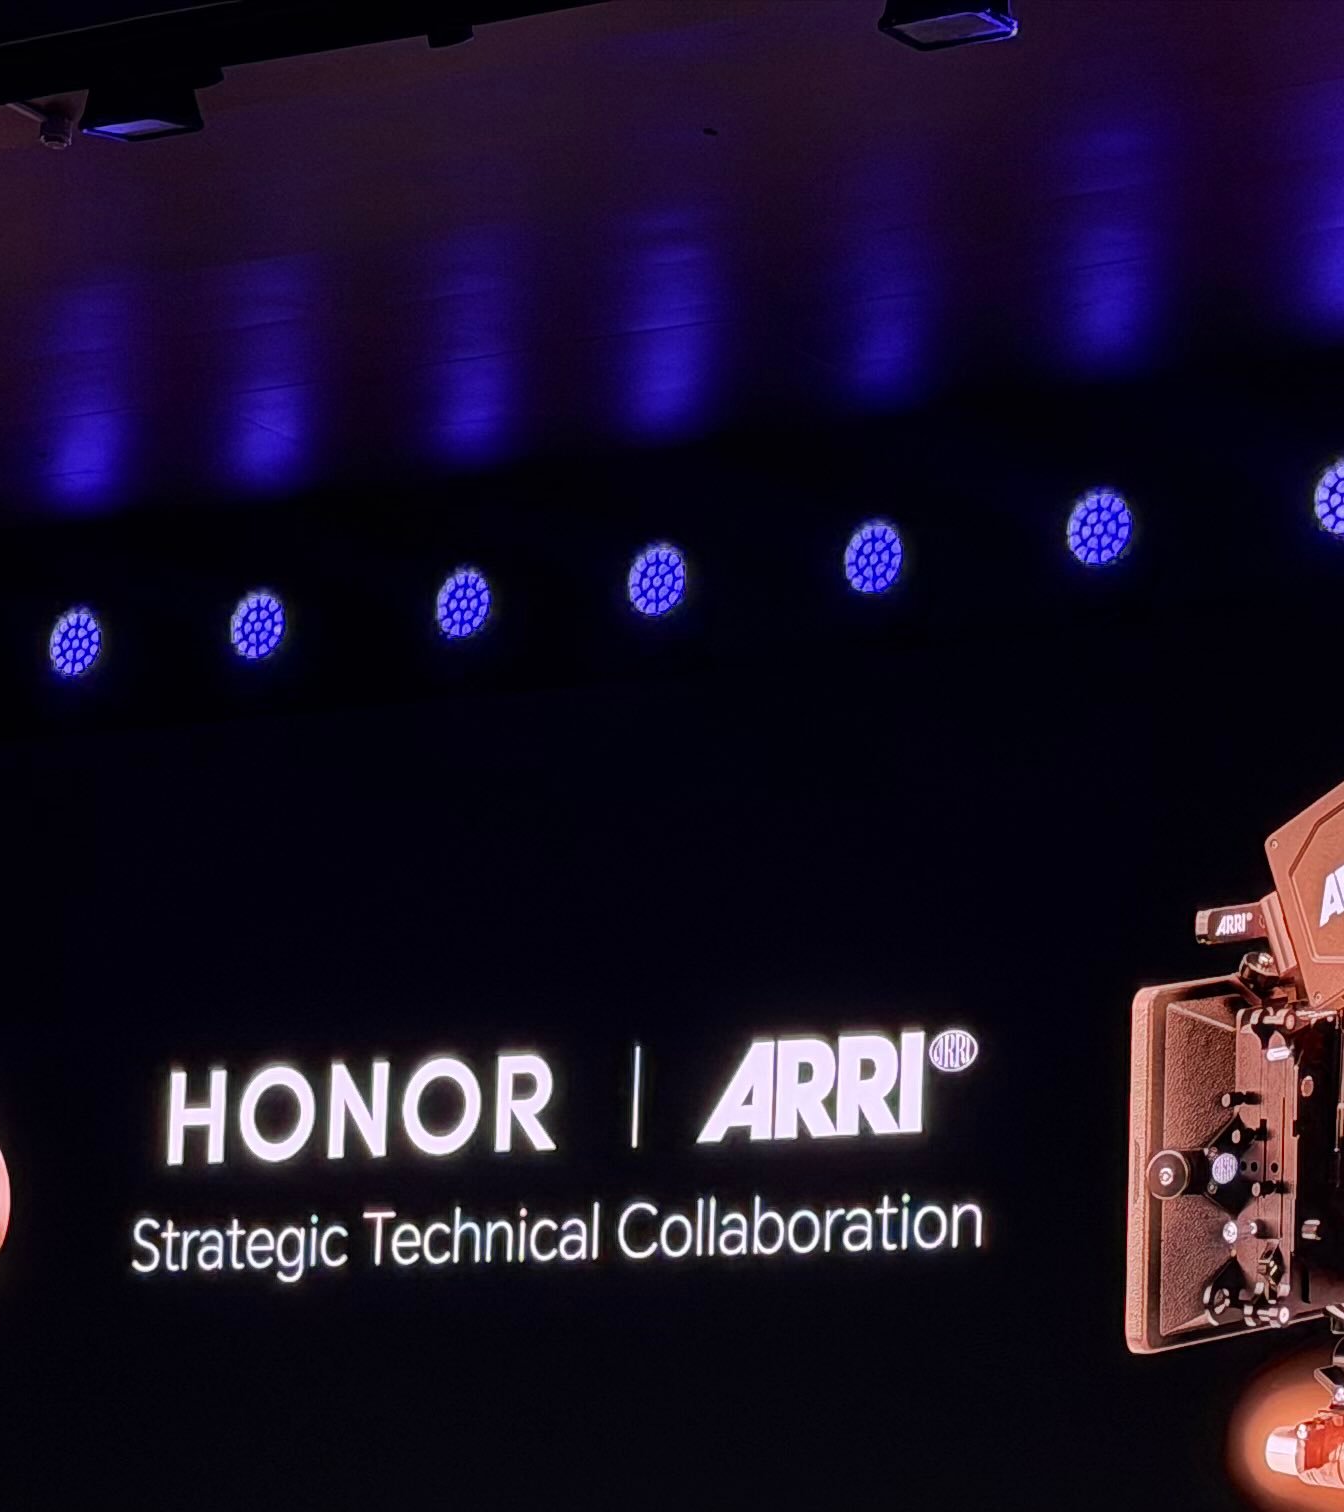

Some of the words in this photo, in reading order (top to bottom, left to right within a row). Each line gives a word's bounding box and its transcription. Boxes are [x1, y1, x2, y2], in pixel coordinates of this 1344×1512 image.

[1215, 912, 1246, 936] ARRI
[167, 1052, 556, 1166] HONOR
[696, 1029, 926, 1143] ARRI
[132, 1215, 349, 1283] Strategic
[363, 1202, 600, 1266] Technical
[618, 1193, 983, 1259] Collaboration
